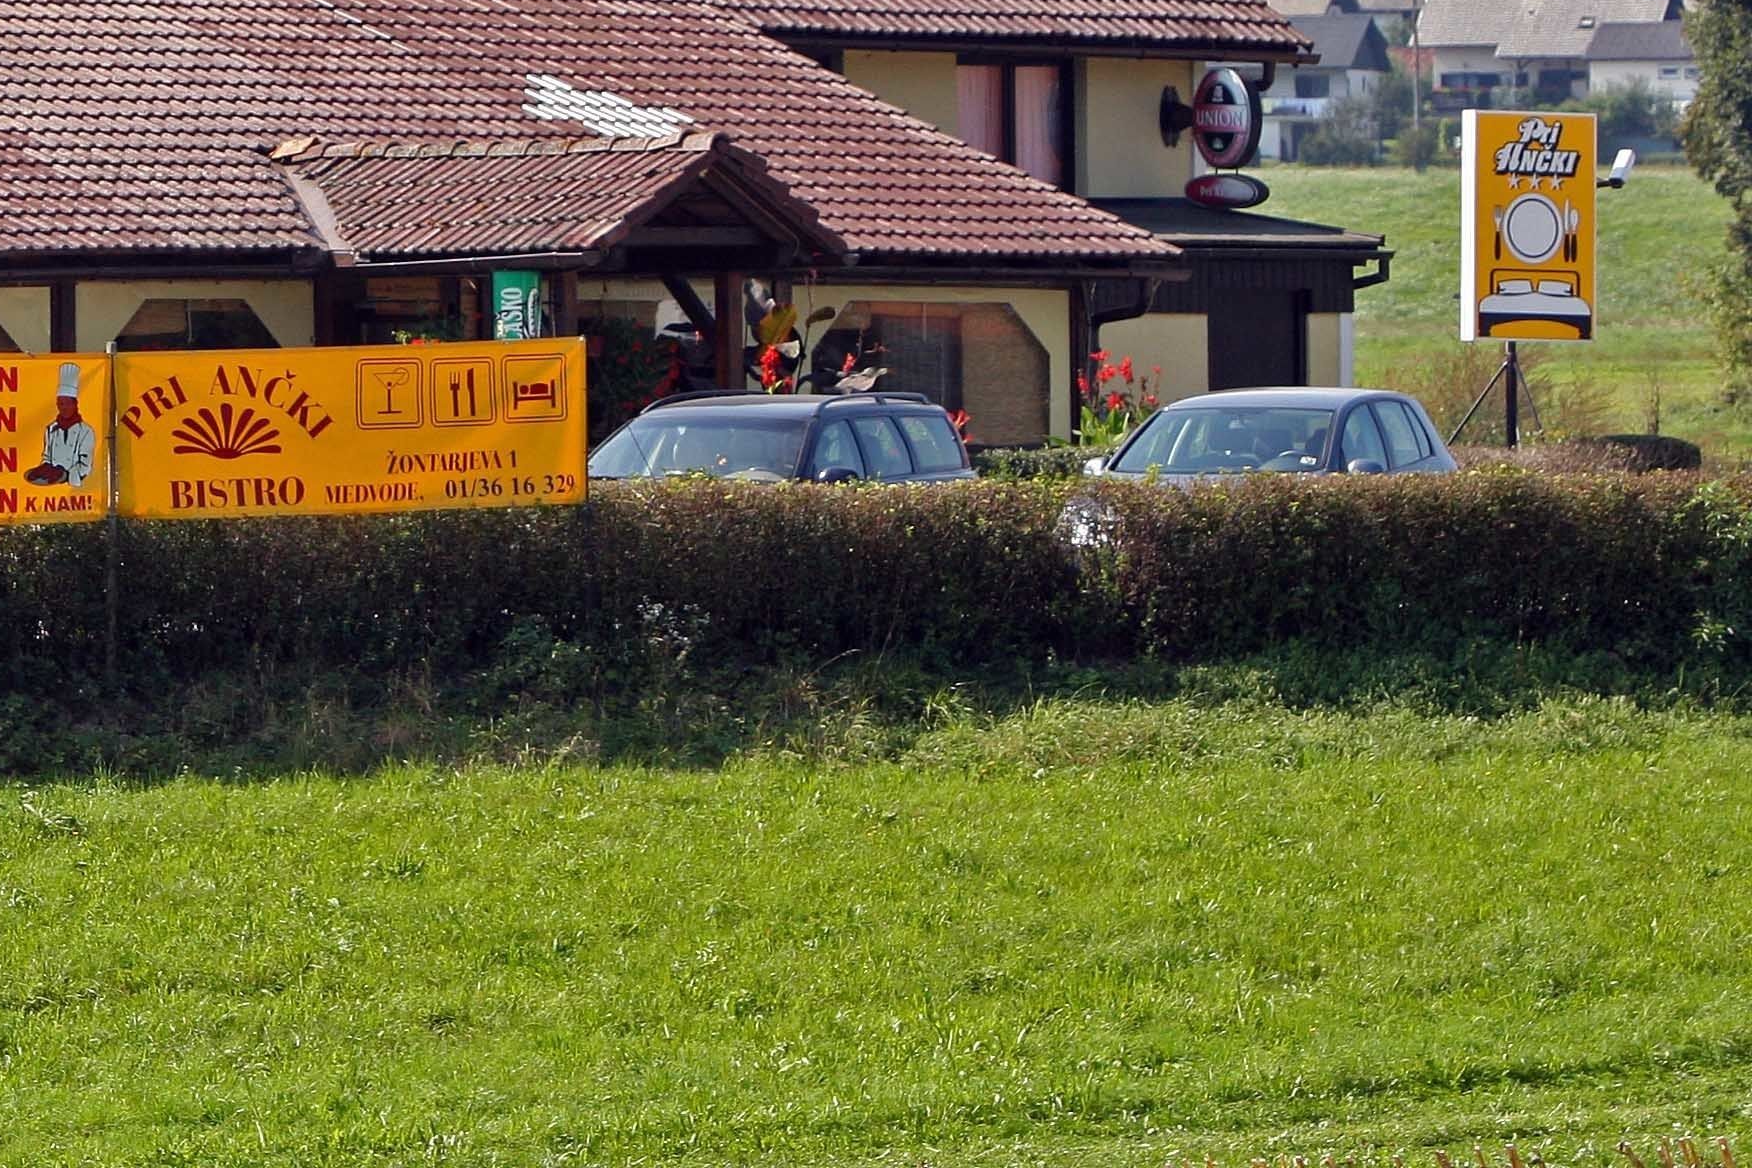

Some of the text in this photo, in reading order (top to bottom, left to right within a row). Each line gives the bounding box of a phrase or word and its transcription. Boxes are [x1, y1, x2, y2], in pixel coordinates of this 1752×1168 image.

[1195, 109, 1242, 128] UNION
[1519, 118, 1561, 143] Pri
[119, 364, 336, 440] PRI ANČKI
[386, 449, 518, 475] ŽONTARJEVA 1
[168, 476, 306, 510] BISTRO
[445, 477, 503, 499] 01/36
[511, 477, 536, 496] 16
[542, 474, 576, 495] 329
[25, 496, 39, 513] K
[44, 495, 93, 513] NAM!
